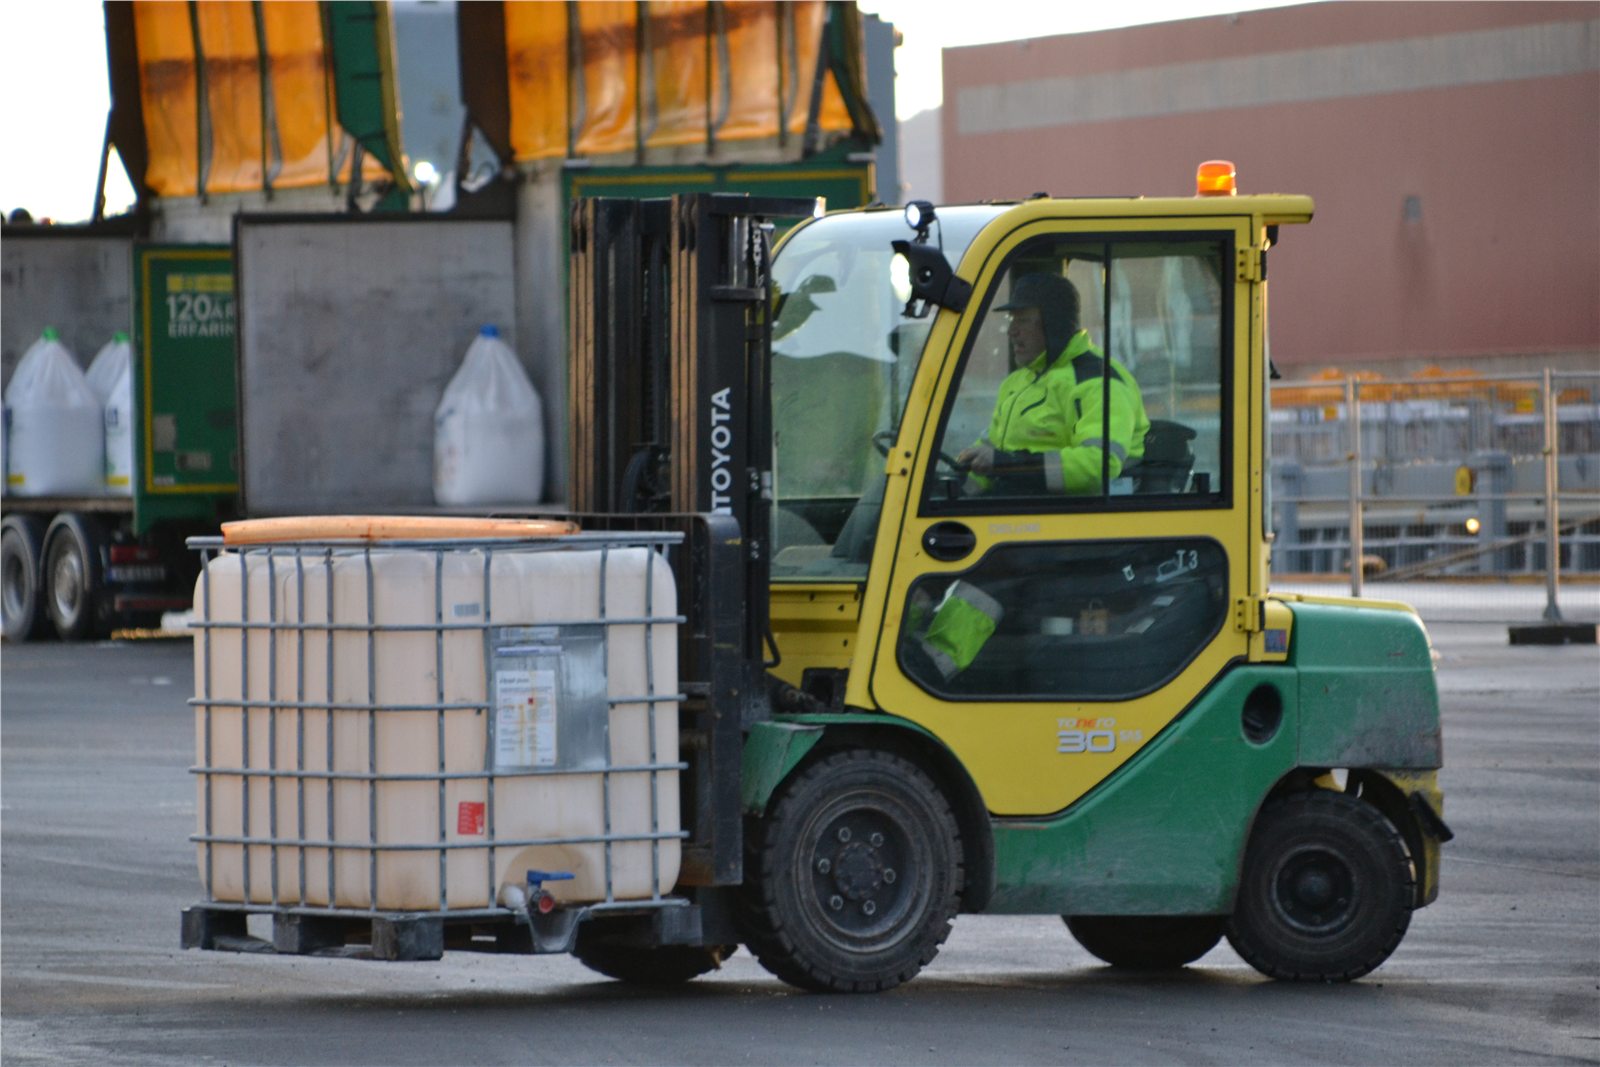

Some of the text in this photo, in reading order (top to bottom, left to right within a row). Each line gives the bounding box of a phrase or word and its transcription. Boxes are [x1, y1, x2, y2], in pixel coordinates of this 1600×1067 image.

[167, 294, 211, 320] 120
[711, 387, 731, 509] TOYOTA
[1056, 730, 1116, 752] 30
